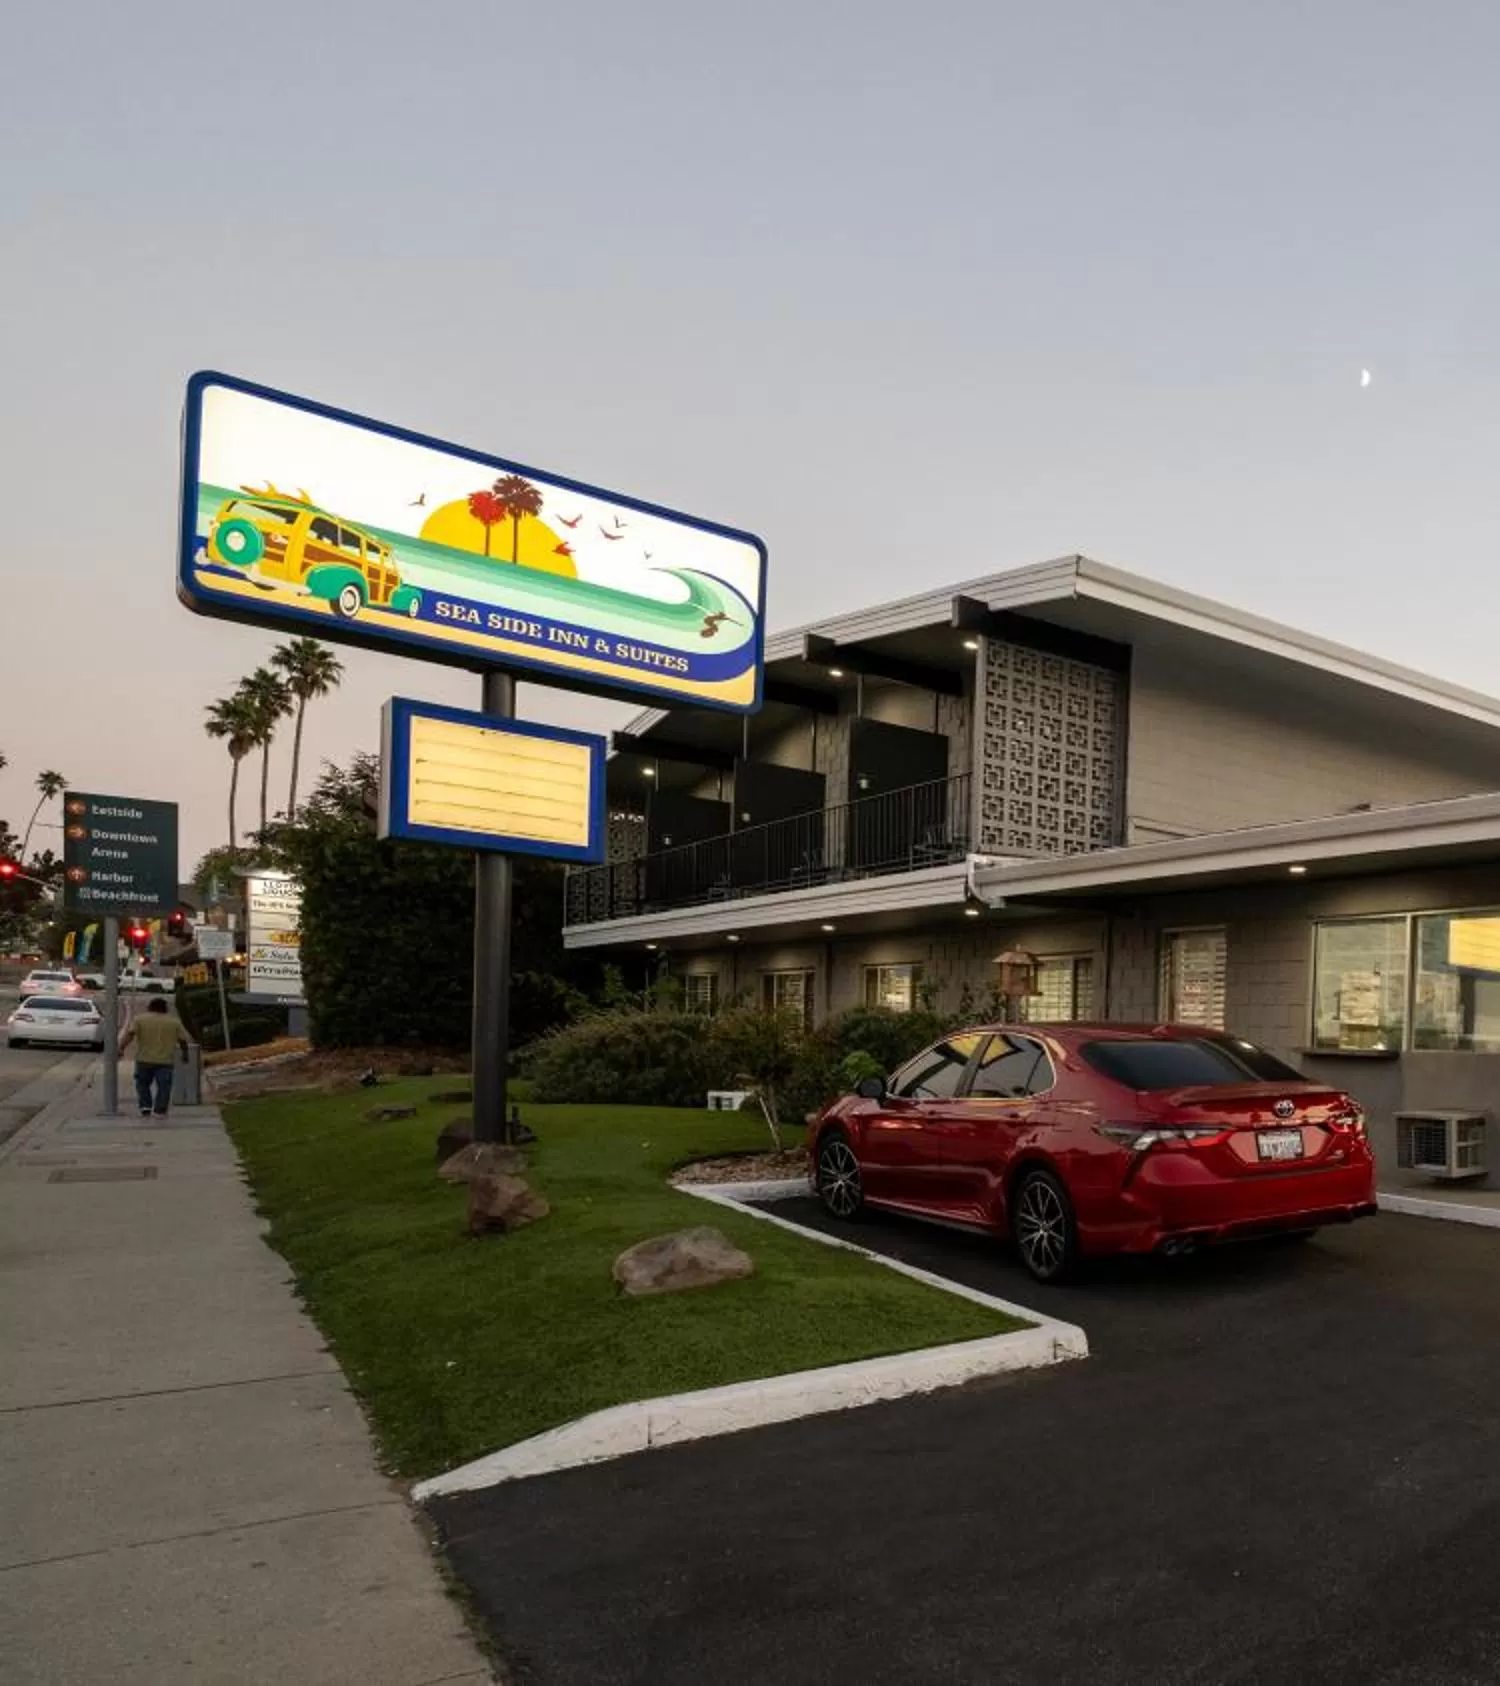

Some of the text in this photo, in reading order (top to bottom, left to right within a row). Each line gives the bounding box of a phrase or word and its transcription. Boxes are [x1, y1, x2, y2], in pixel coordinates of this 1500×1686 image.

[435, 601, 689, 673] SEA SIDE INN & SUITES
[92, 804, 143, 819] Eastside
[92, 829, 158, 844] Downtown
[92, 847, 128, 858] Arena
[92, 871, 133, 883] Harbor
[92, 888, 159, 903] Beachfront
